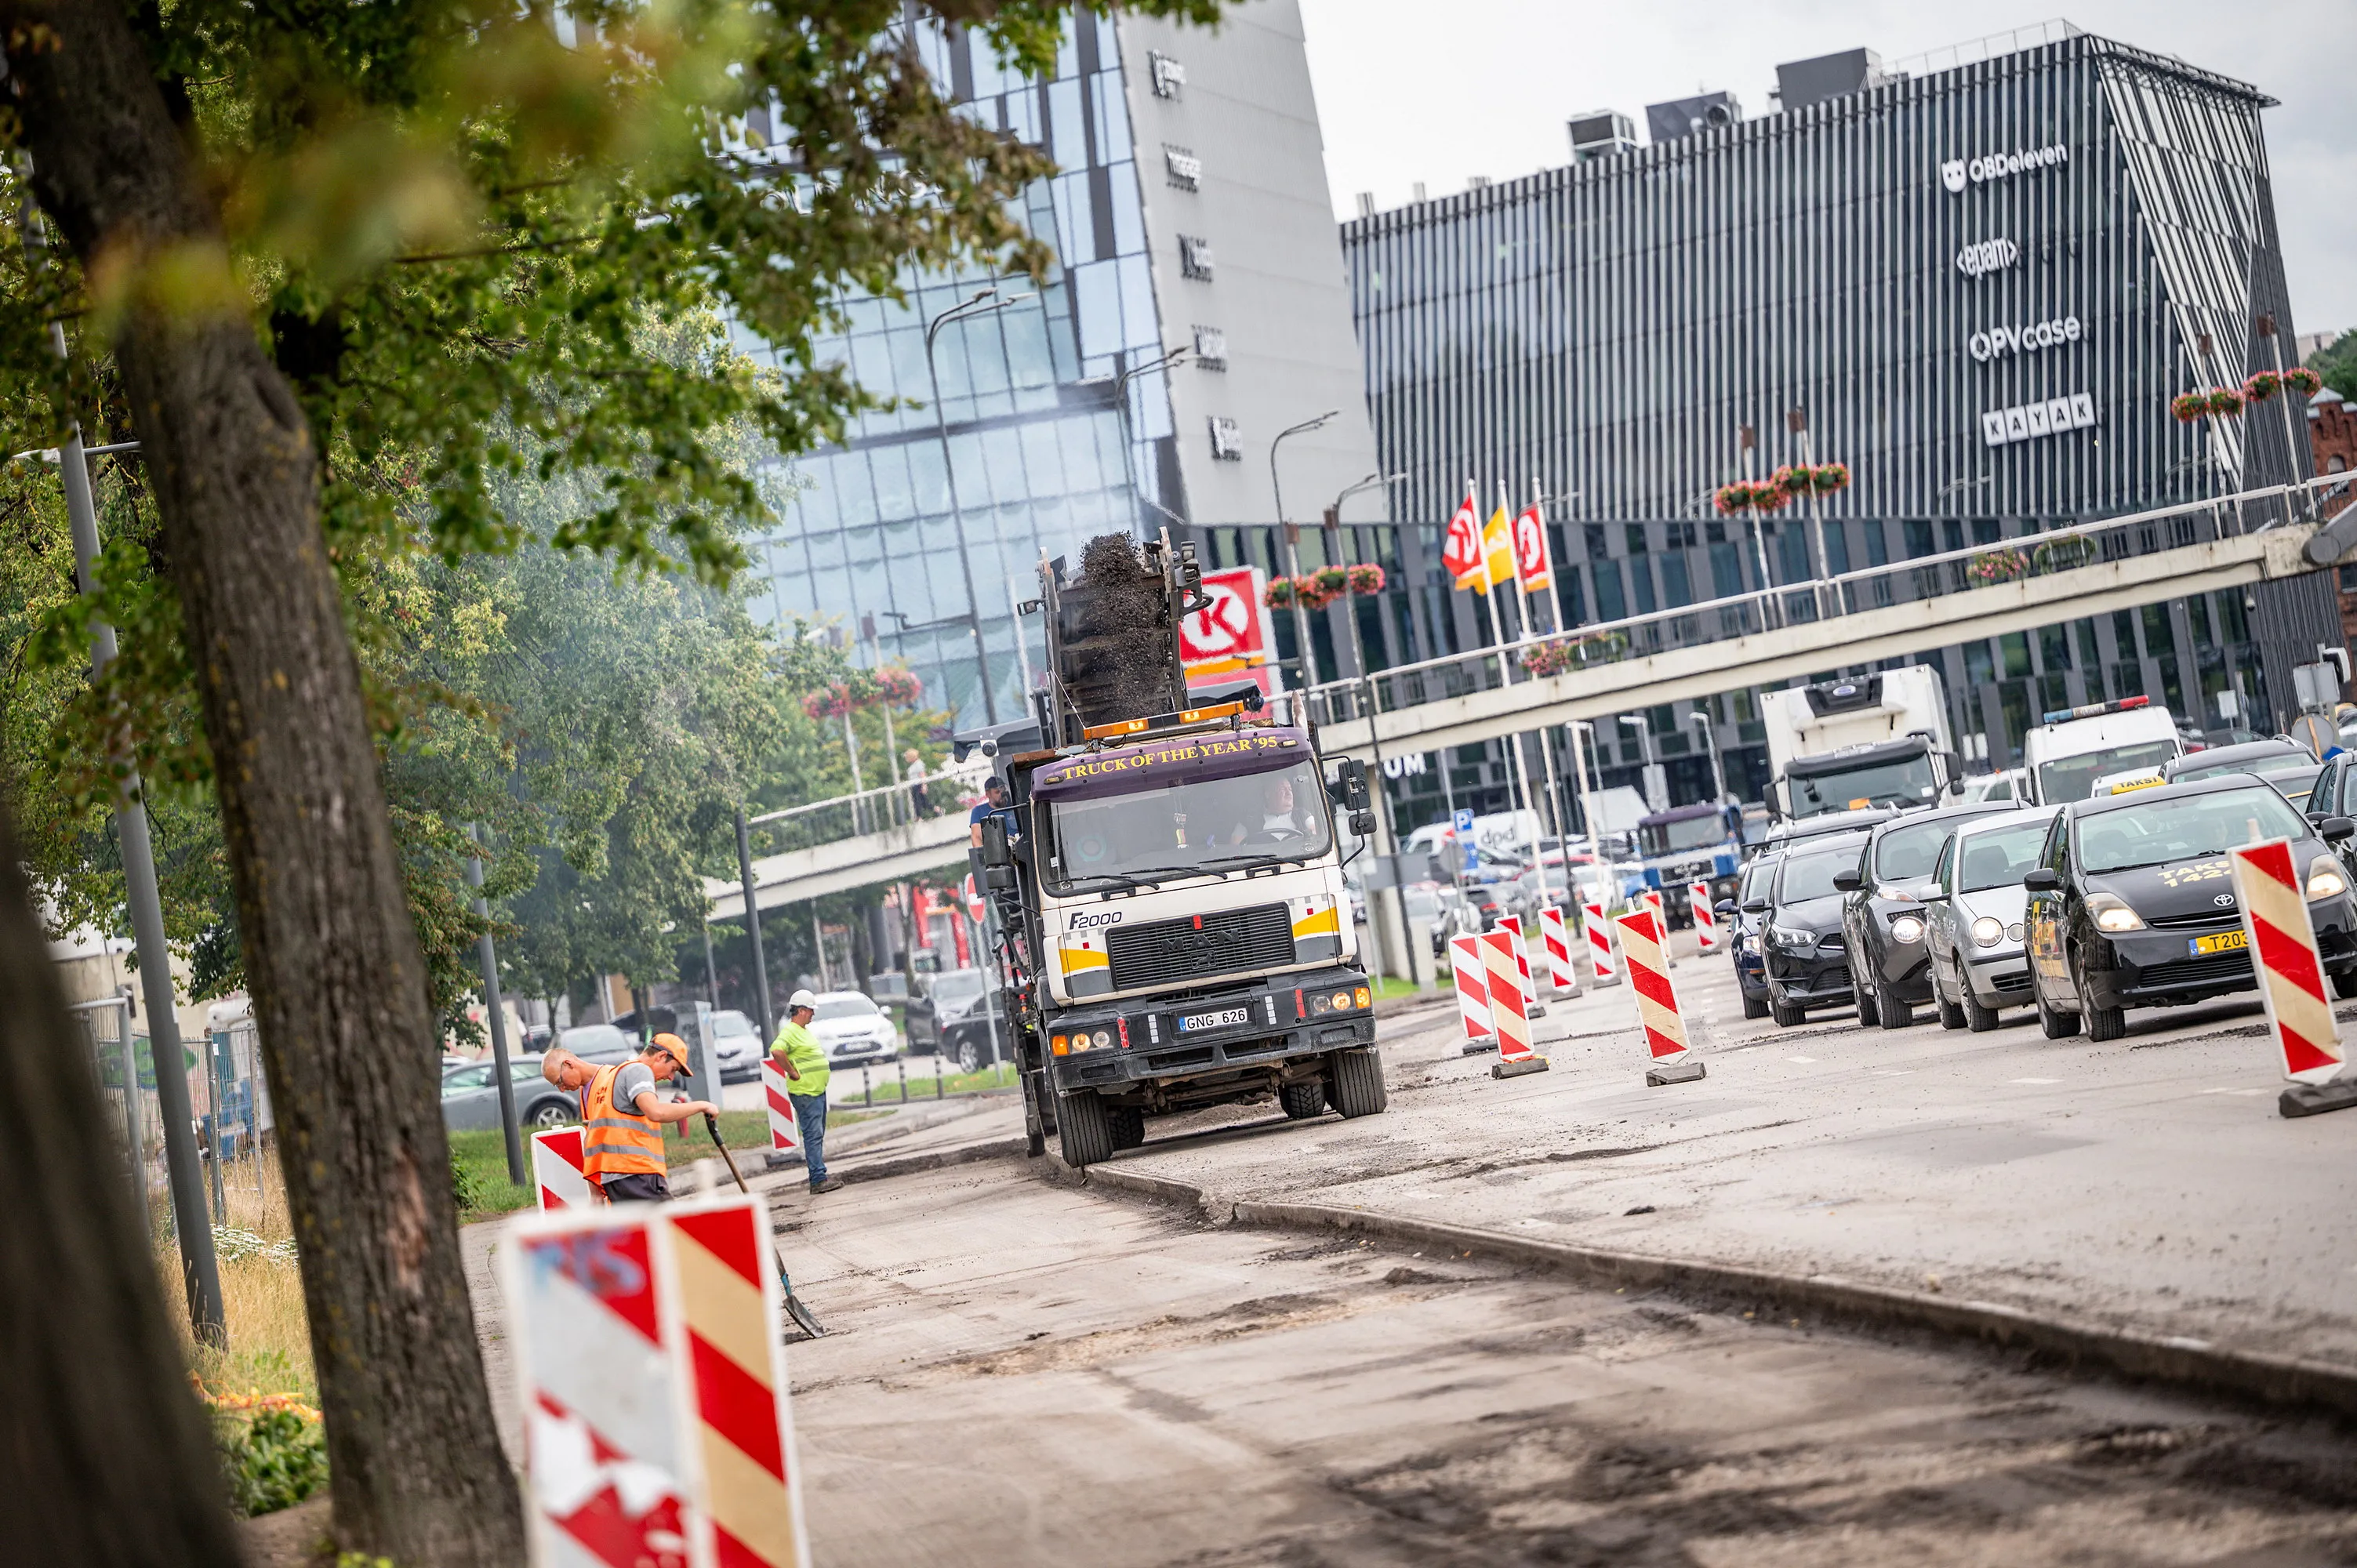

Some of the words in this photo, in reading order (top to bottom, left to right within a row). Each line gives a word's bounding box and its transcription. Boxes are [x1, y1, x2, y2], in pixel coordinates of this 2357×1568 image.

[1969, 143, 2068, 183] OBDeleven
[1989, 401, 2087, 436] KAYAK
[1062, 758, 1128, 780] TRUCK
[1131, 754, 1155, 768] OF
[1157, 746, 1199, 764] THE
[1200, 739, 1252, 757] YEAR
[2119, 777, 2158, 788] TAKSI
[1455, 814, 1472, 831] P
[1480, 828, 1514, 850] dpd
[1069, 911, 1122, 931] F2000
[1161, 928, 1240, 954] MAN
[1187, 1014, 1214, 1029] GNG
[1222, 1010, 1246, 1023] 626
